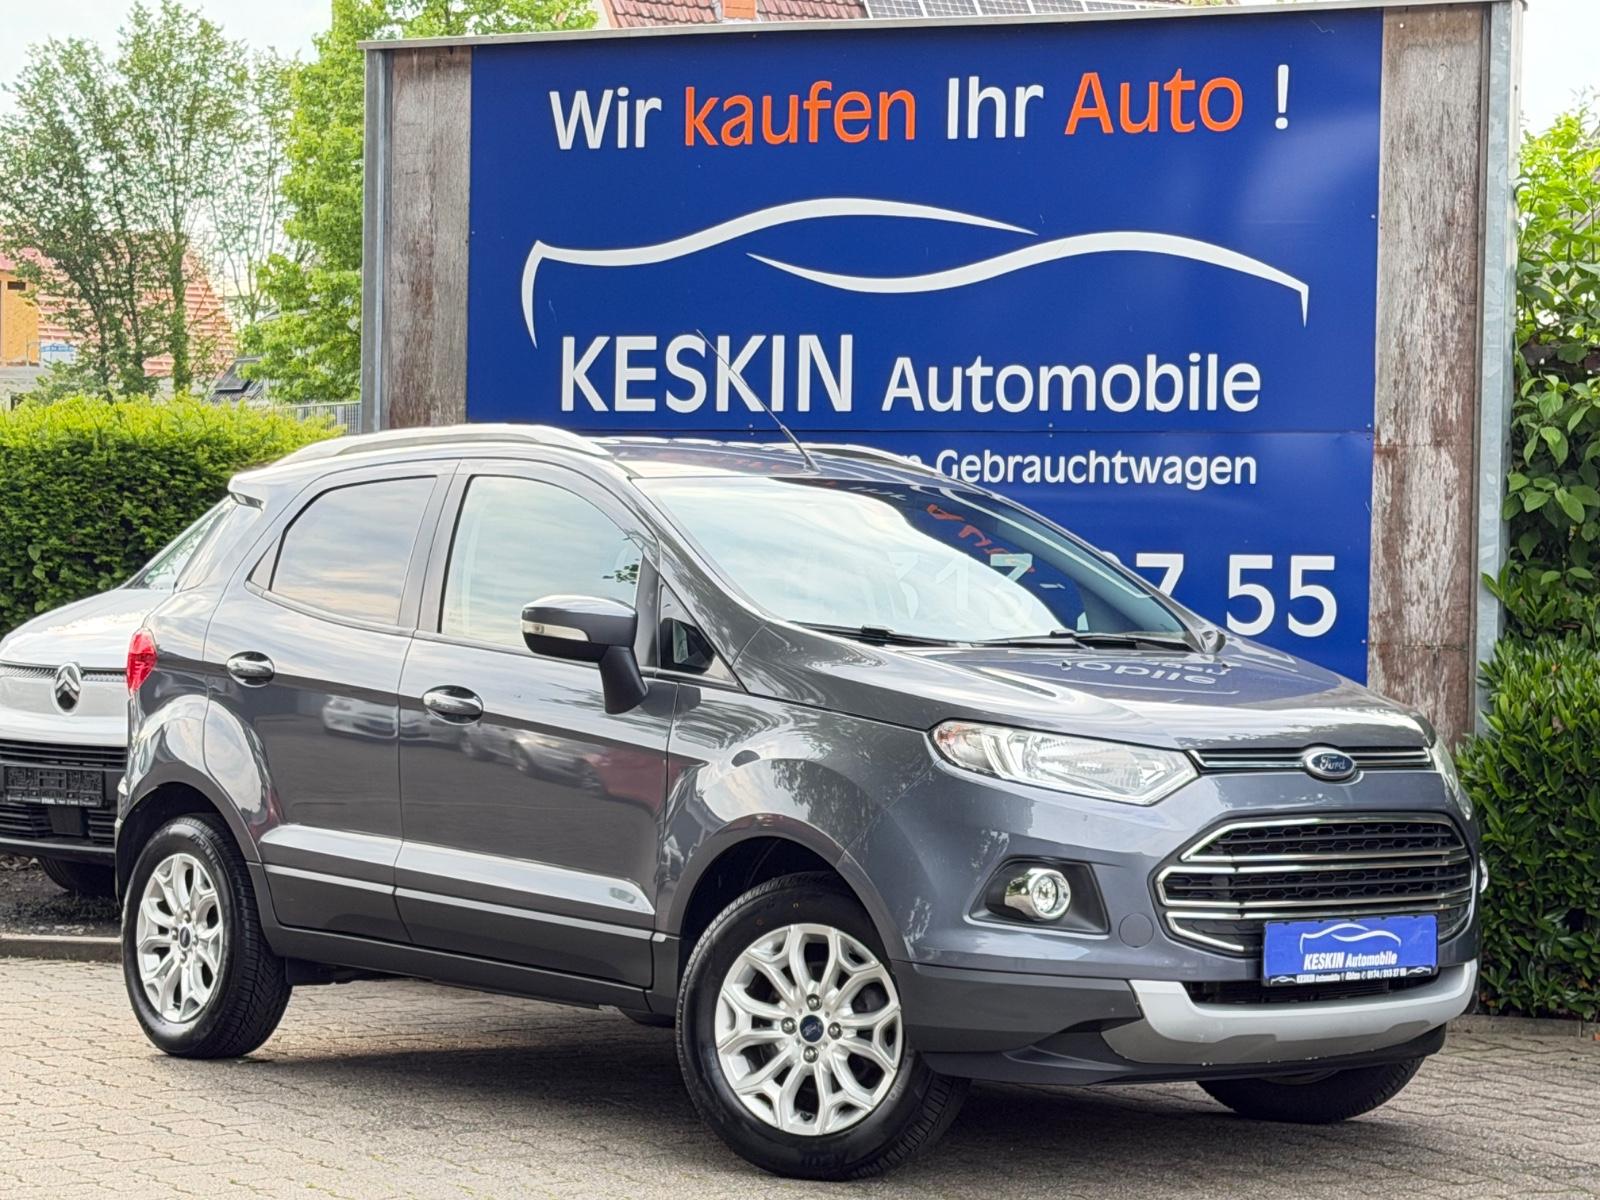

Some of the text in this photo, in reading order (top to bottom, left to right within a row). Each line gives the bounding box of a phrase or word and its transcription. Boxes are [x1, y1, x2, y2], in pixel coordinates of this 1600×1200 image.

[550, 65, 1289, 150] Wir kaufen Ihr Auto !
[562, 335, 1260, 413] KESKIN Automobile
[937, 449, 1256, 490] Gebrauchtwagen
[1227, 555, 1337, 638] 55
[1320, 755, 1346, 770] Ford
[1304, 951, 1398, 970] KESKIN Automobile
